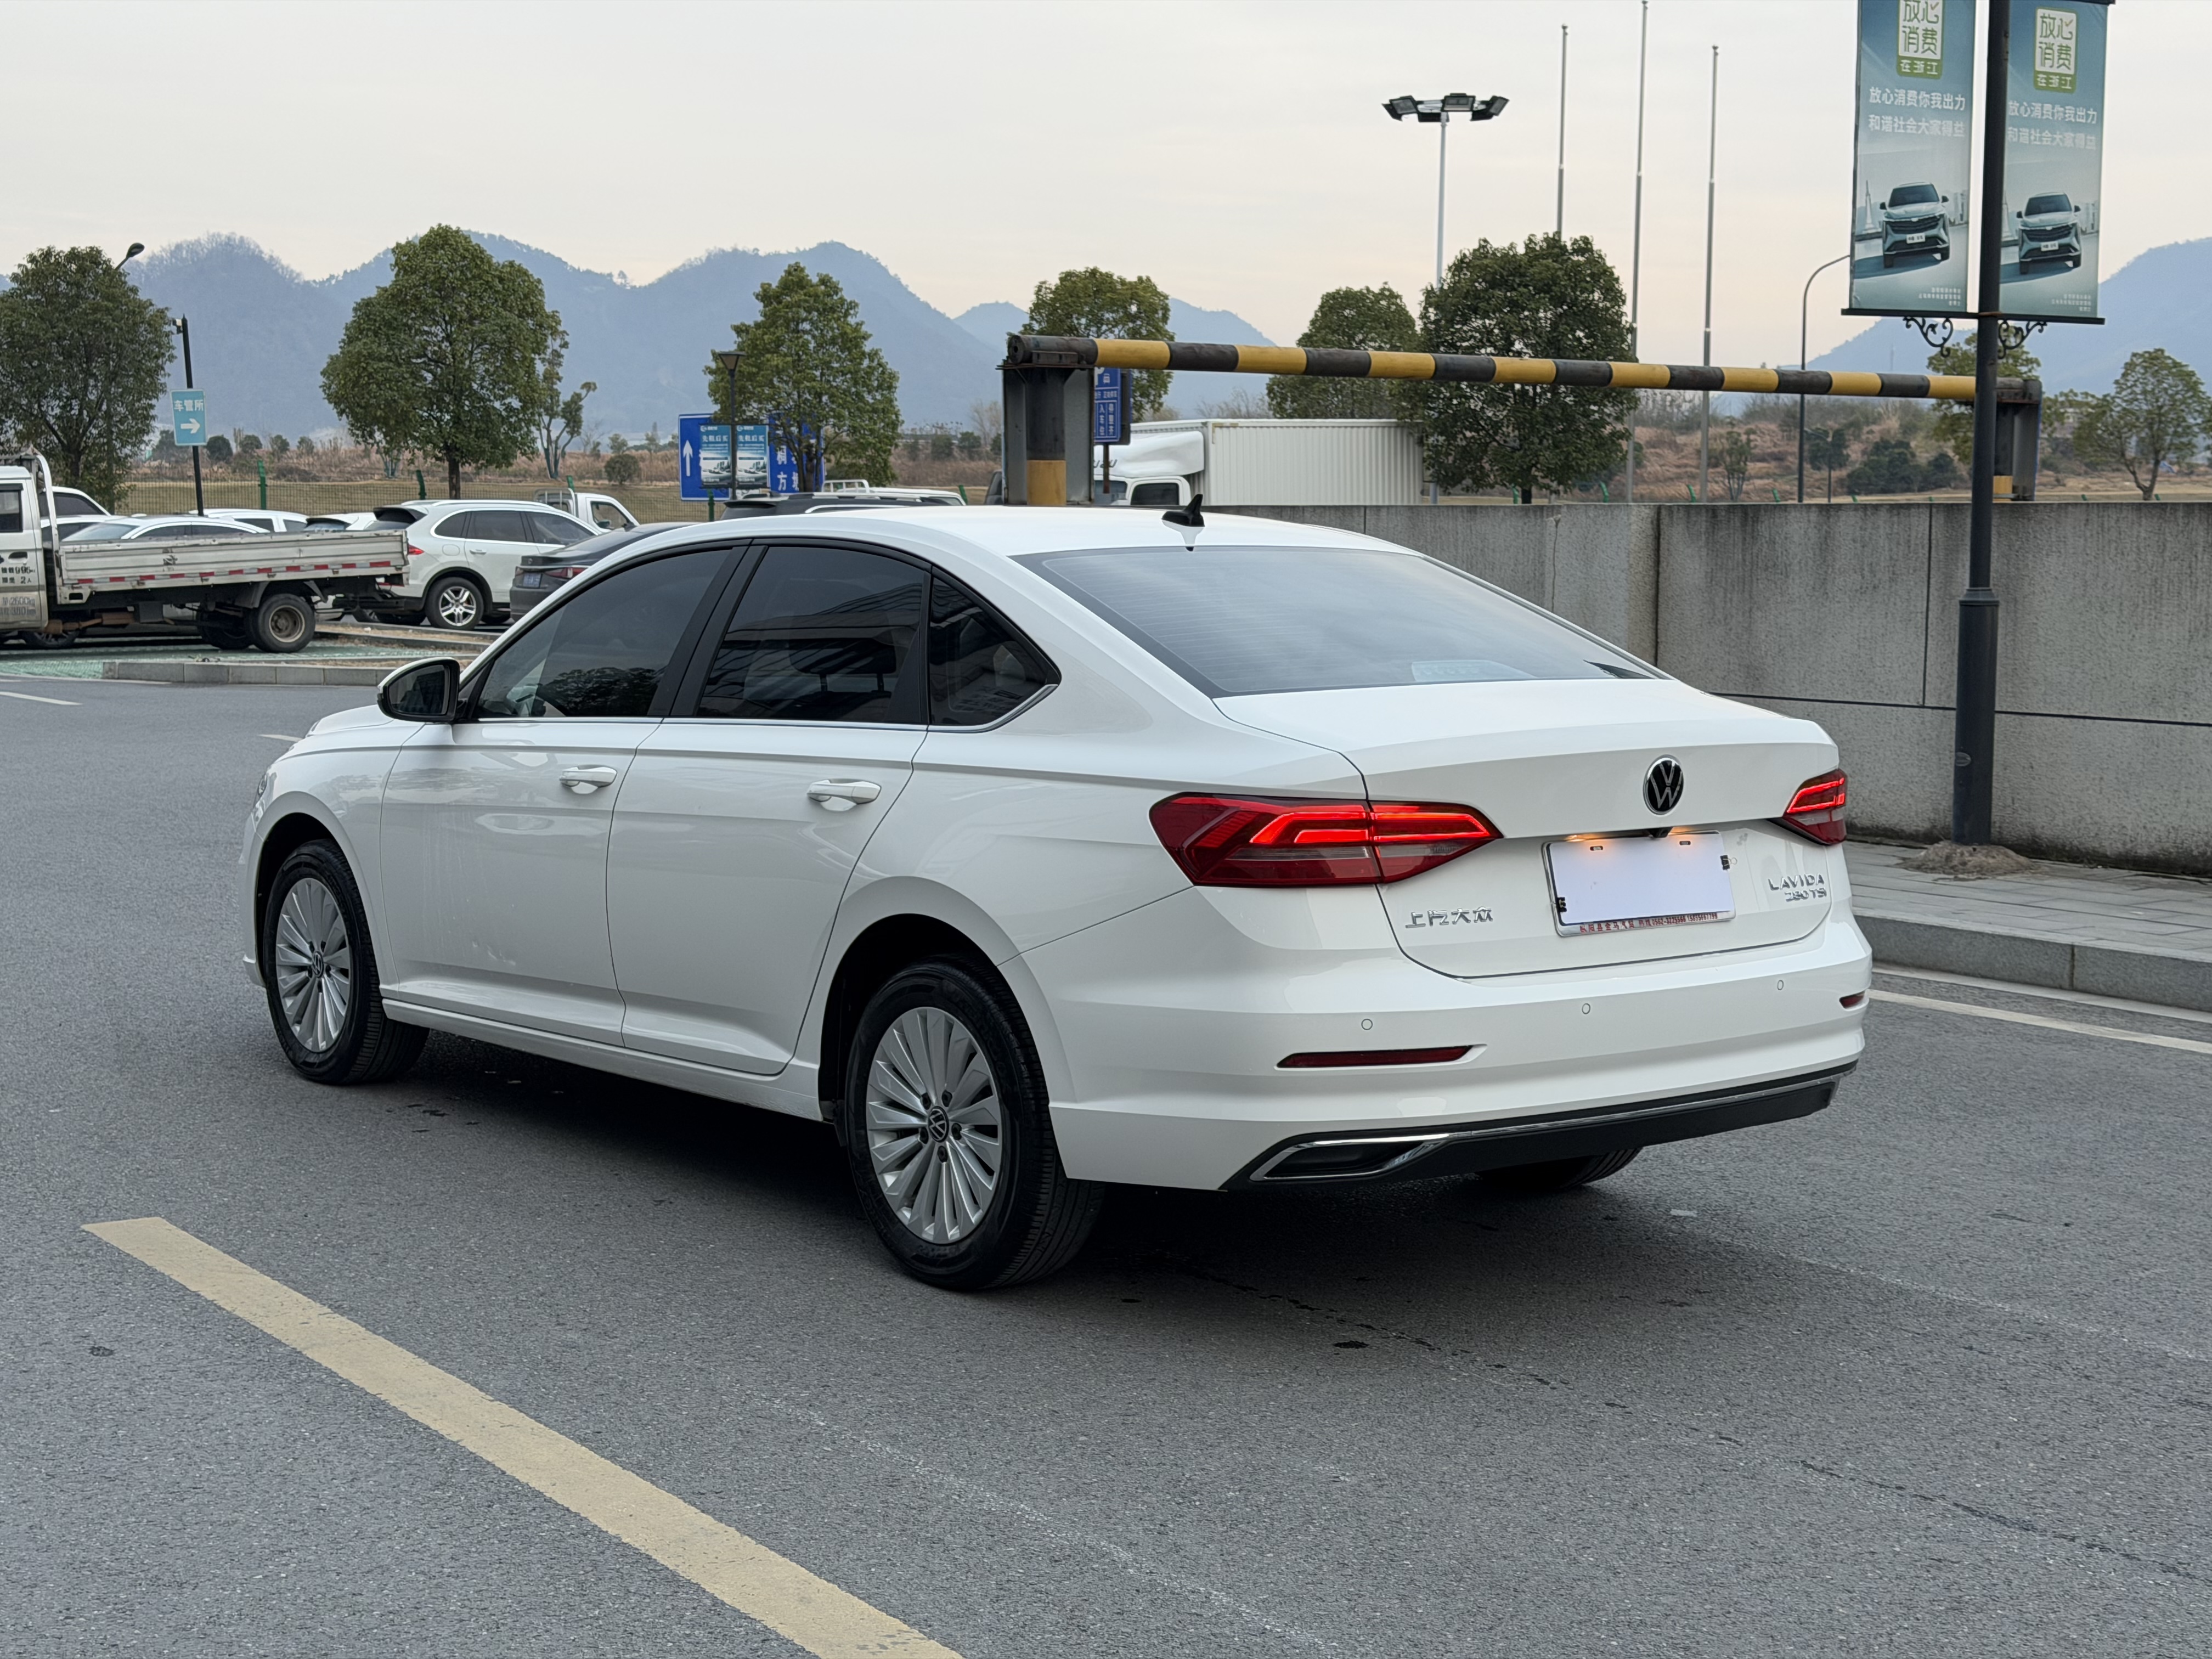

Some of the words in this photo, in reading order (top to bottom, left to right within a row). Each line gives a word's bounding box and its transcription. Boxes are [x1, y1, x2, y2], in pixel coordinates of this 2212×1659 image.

[2039, 13, 2074, 40] 放心
[1901, 25, 1938, 55] 消费
[1900, 59, 1938, 75] 在浙江
[2038, 41, 2072, 70] 消费
[2036, 74, 2072, 90] 在浙江
[1869, 86, 1966, 111] 放心消费你我出力
[2008, 100, 2097, 125] 放心消费你我出力
[1868, 114, 1966, 137] 和谐社会大家得益
[2007, 126, 2097, 150] 和谐社会大家得益
[174, 399, 204, 411] 车管所
[1768, 873, 1825, 891] LAVIDA
[1405, 906, 1493, 928] 上汽大众
